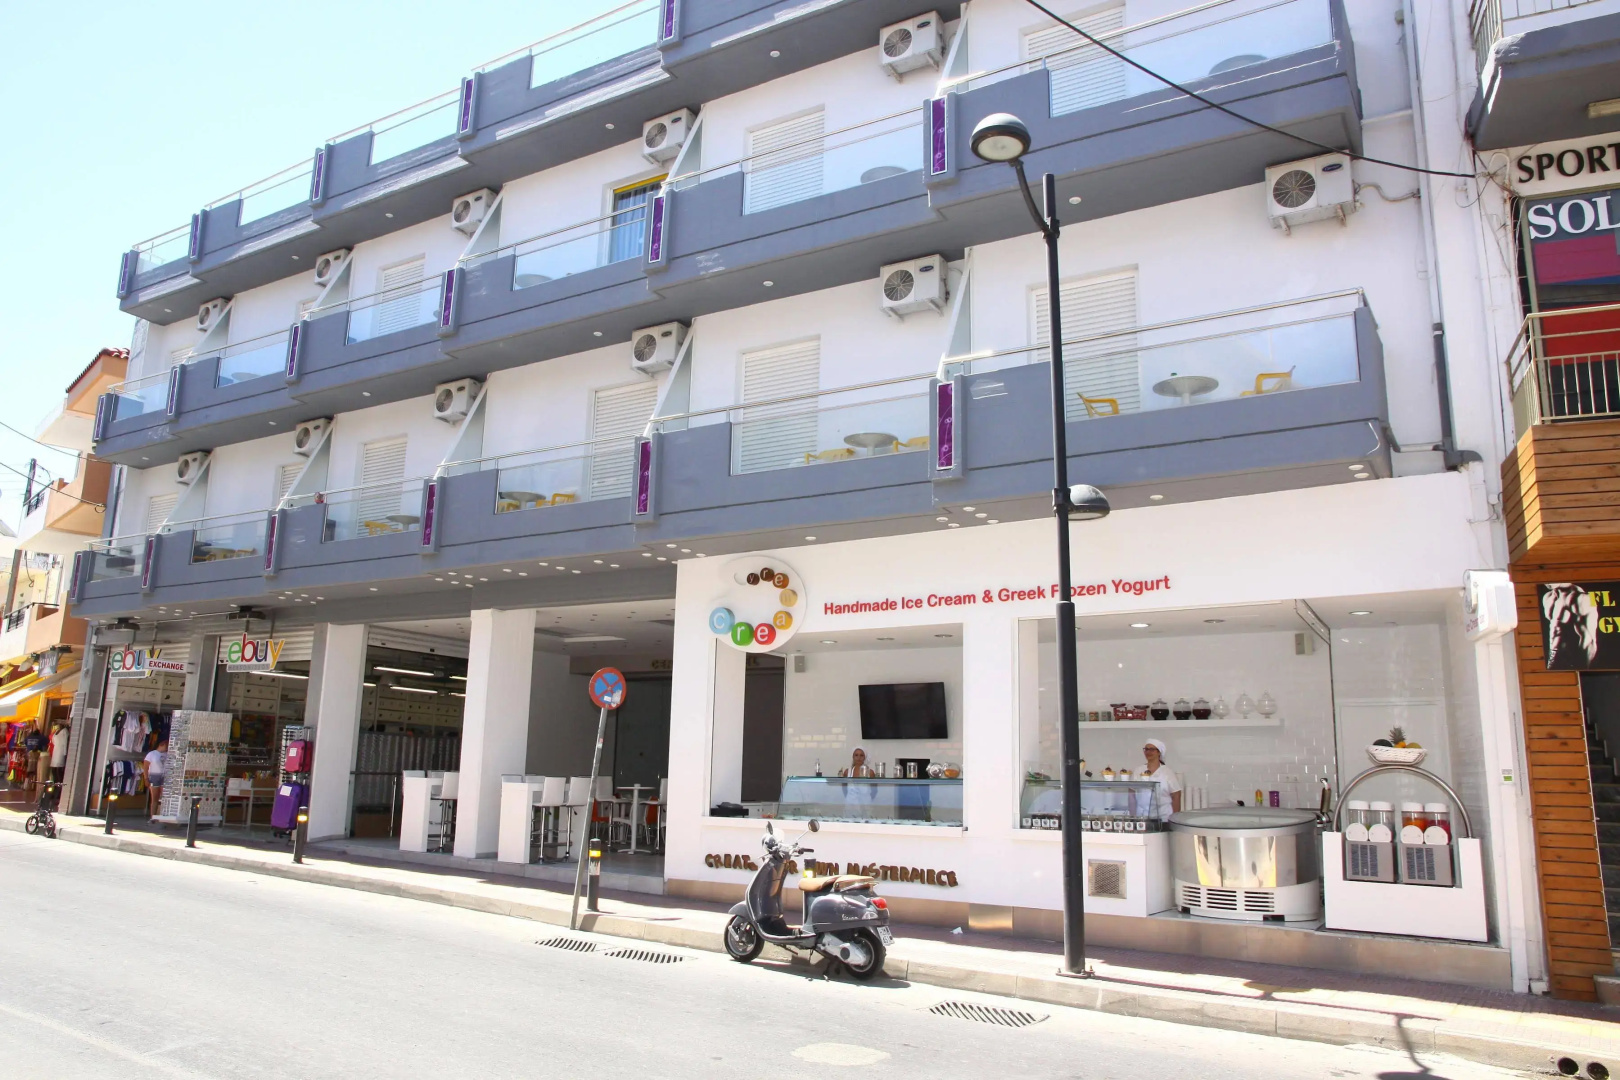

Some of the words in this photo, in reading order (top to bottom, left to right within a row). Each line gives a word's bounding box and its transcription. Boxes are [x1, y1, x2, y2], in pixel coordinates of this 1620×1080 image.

[823, 597, 898, 615] Handmade
[901, 596, 924, 611] Ice
[926, 592, 977, 608] Cream
[981, 589, 994, 604] &
[998, 585, 1047, 602] Greek
[1050, 582, 1107, 599] Fozen
[1111, 575, 1171, 597] Yogurt
[148, 660, 184, 671] EXCHANGE
[227, 633, 285, 669] ebuy
[846, 862, 959, 888] MASTERPIECE
